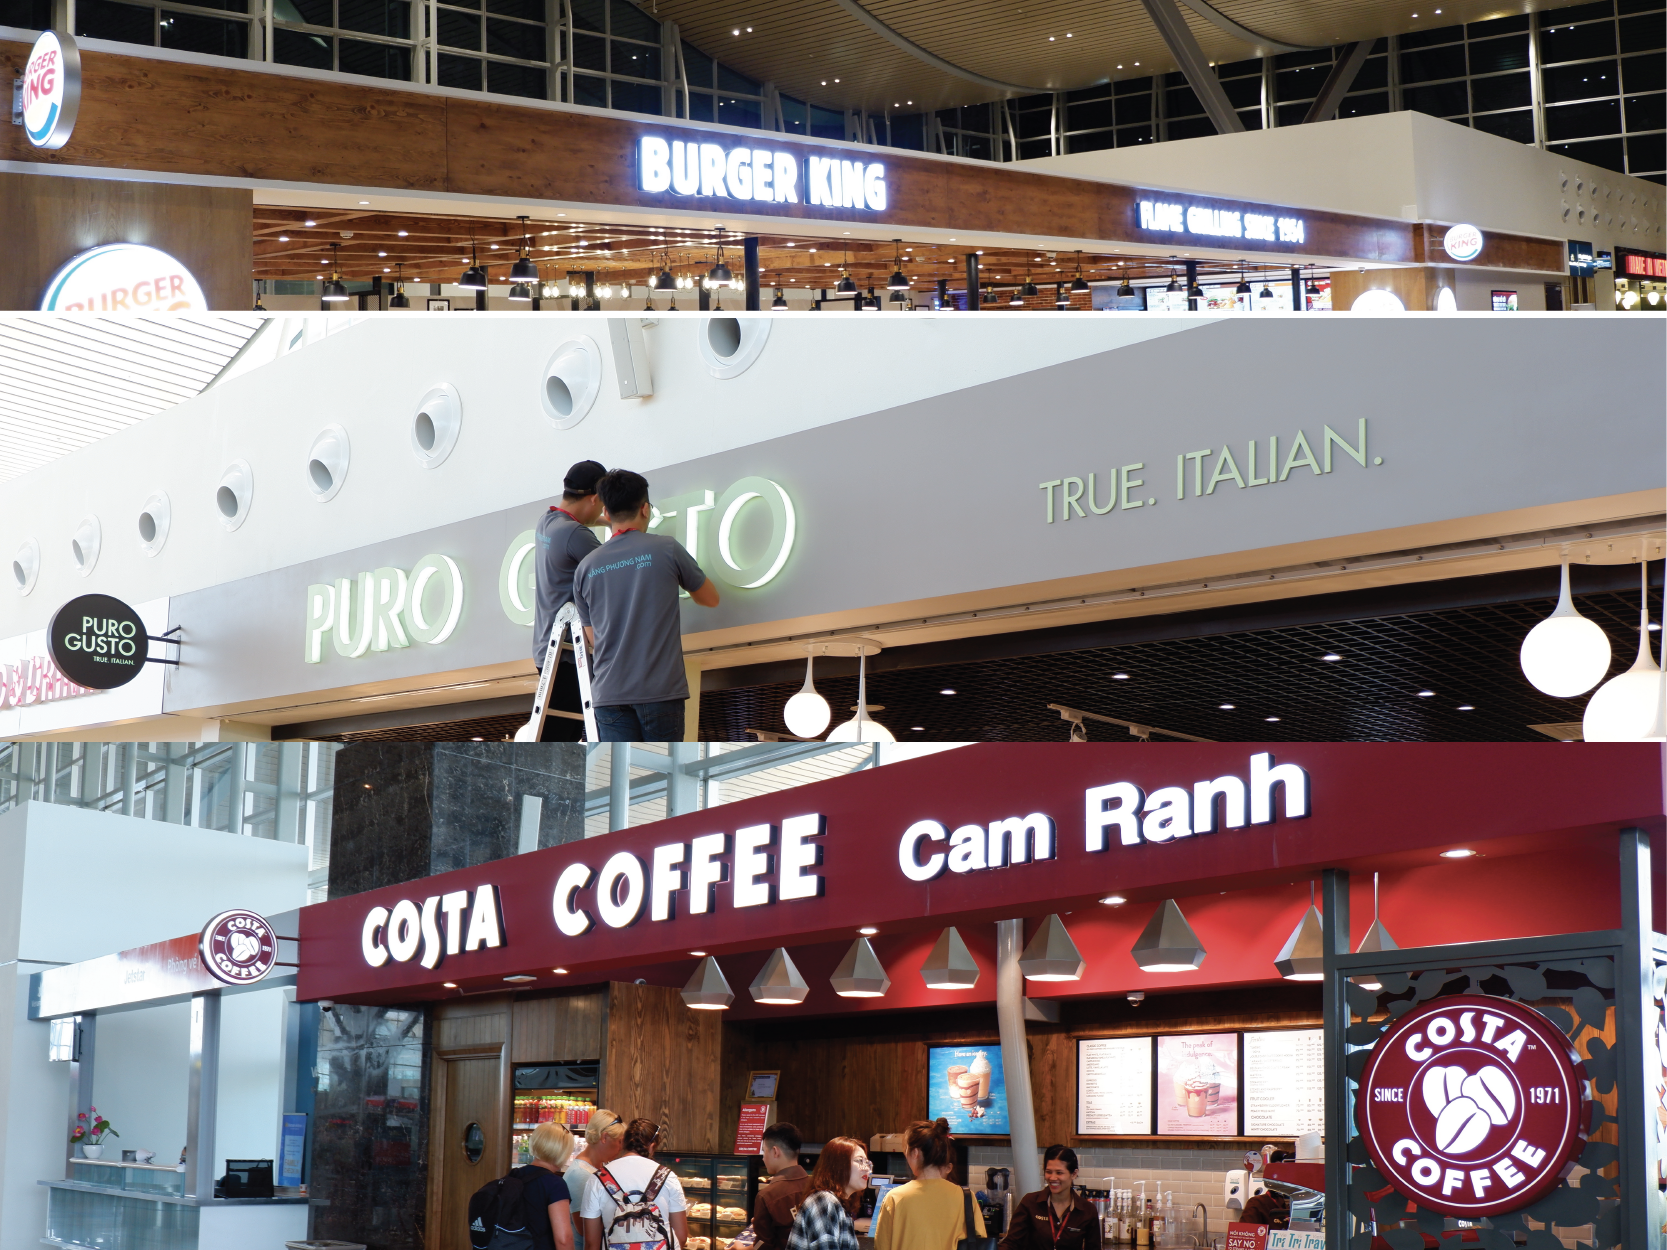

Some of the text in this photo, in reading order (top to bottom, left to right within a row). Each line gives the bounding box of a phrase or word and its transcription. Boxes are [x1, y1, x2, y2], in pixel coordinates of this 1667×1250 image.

[637, 137, 887, 211] BURGER KING
[1451, 237, 1477, 250] KING
[1039, 417, 1384, 524] TRUE. ITALIAN.
[304, 476, 797, 664] PURO GTO
[634, 554, 652, 563] NAM
[82, 616, 136, 638] PURO
[64, 633, 136, 656] GUSTO
[93, 656, 135, 666] TRUE. ITALIAN.
[361, 752, 1311, 969] COSTA COFFEE Cam Ranh
[227, 917, 267, 939] COSTA
[124, 968, 145, 985] Jetstar
[167, 956, 188, 975] Phòng
[215, 953, 267, 977] COFFEE
[1405, 1011, 1527, 1064] COSTA
[1374, 1087, 1560, 1104] SINCE 1971
[1392, 1139, 1547, 1199] COFFEE
[1228, 1238, 1256, 1248] SAY NO
